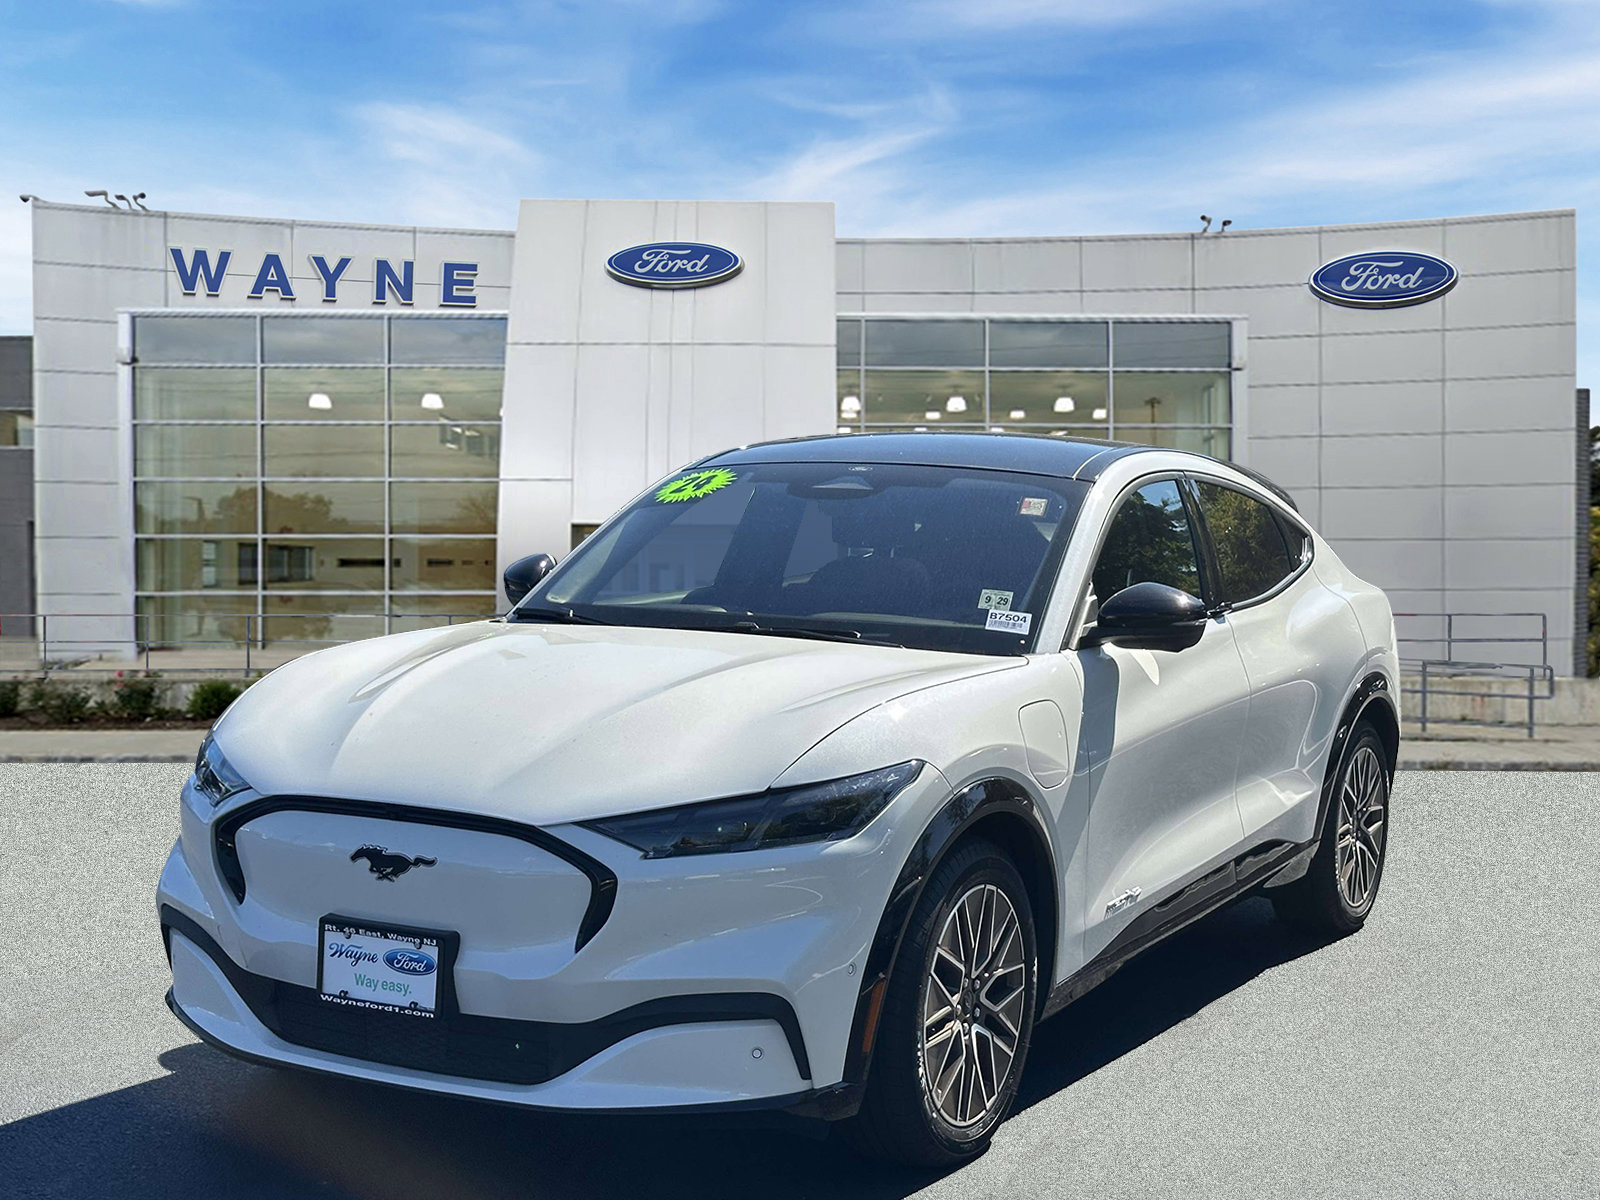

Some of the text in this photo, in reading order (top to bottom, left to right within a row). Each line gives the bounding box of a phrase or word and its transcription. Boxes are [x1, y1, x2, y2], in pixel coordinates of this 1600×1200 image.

[634, 249, 710, 273] Ford
[169, 246, 479, 306] WAYNE
[1341, 261, 1424, 290] Ford
[984, 596, 1009, 606] 9 29
[989, 612, 1027, 623] B7504
[387, 932, 421, 944] Wayne
[423, 938, 437, 946] NJ
[328, 942, 426, 972] Wayne Ford
[354, 973, 412, 996] Way easy.
[320, 994, 434, 1018] Wayneford1.com
